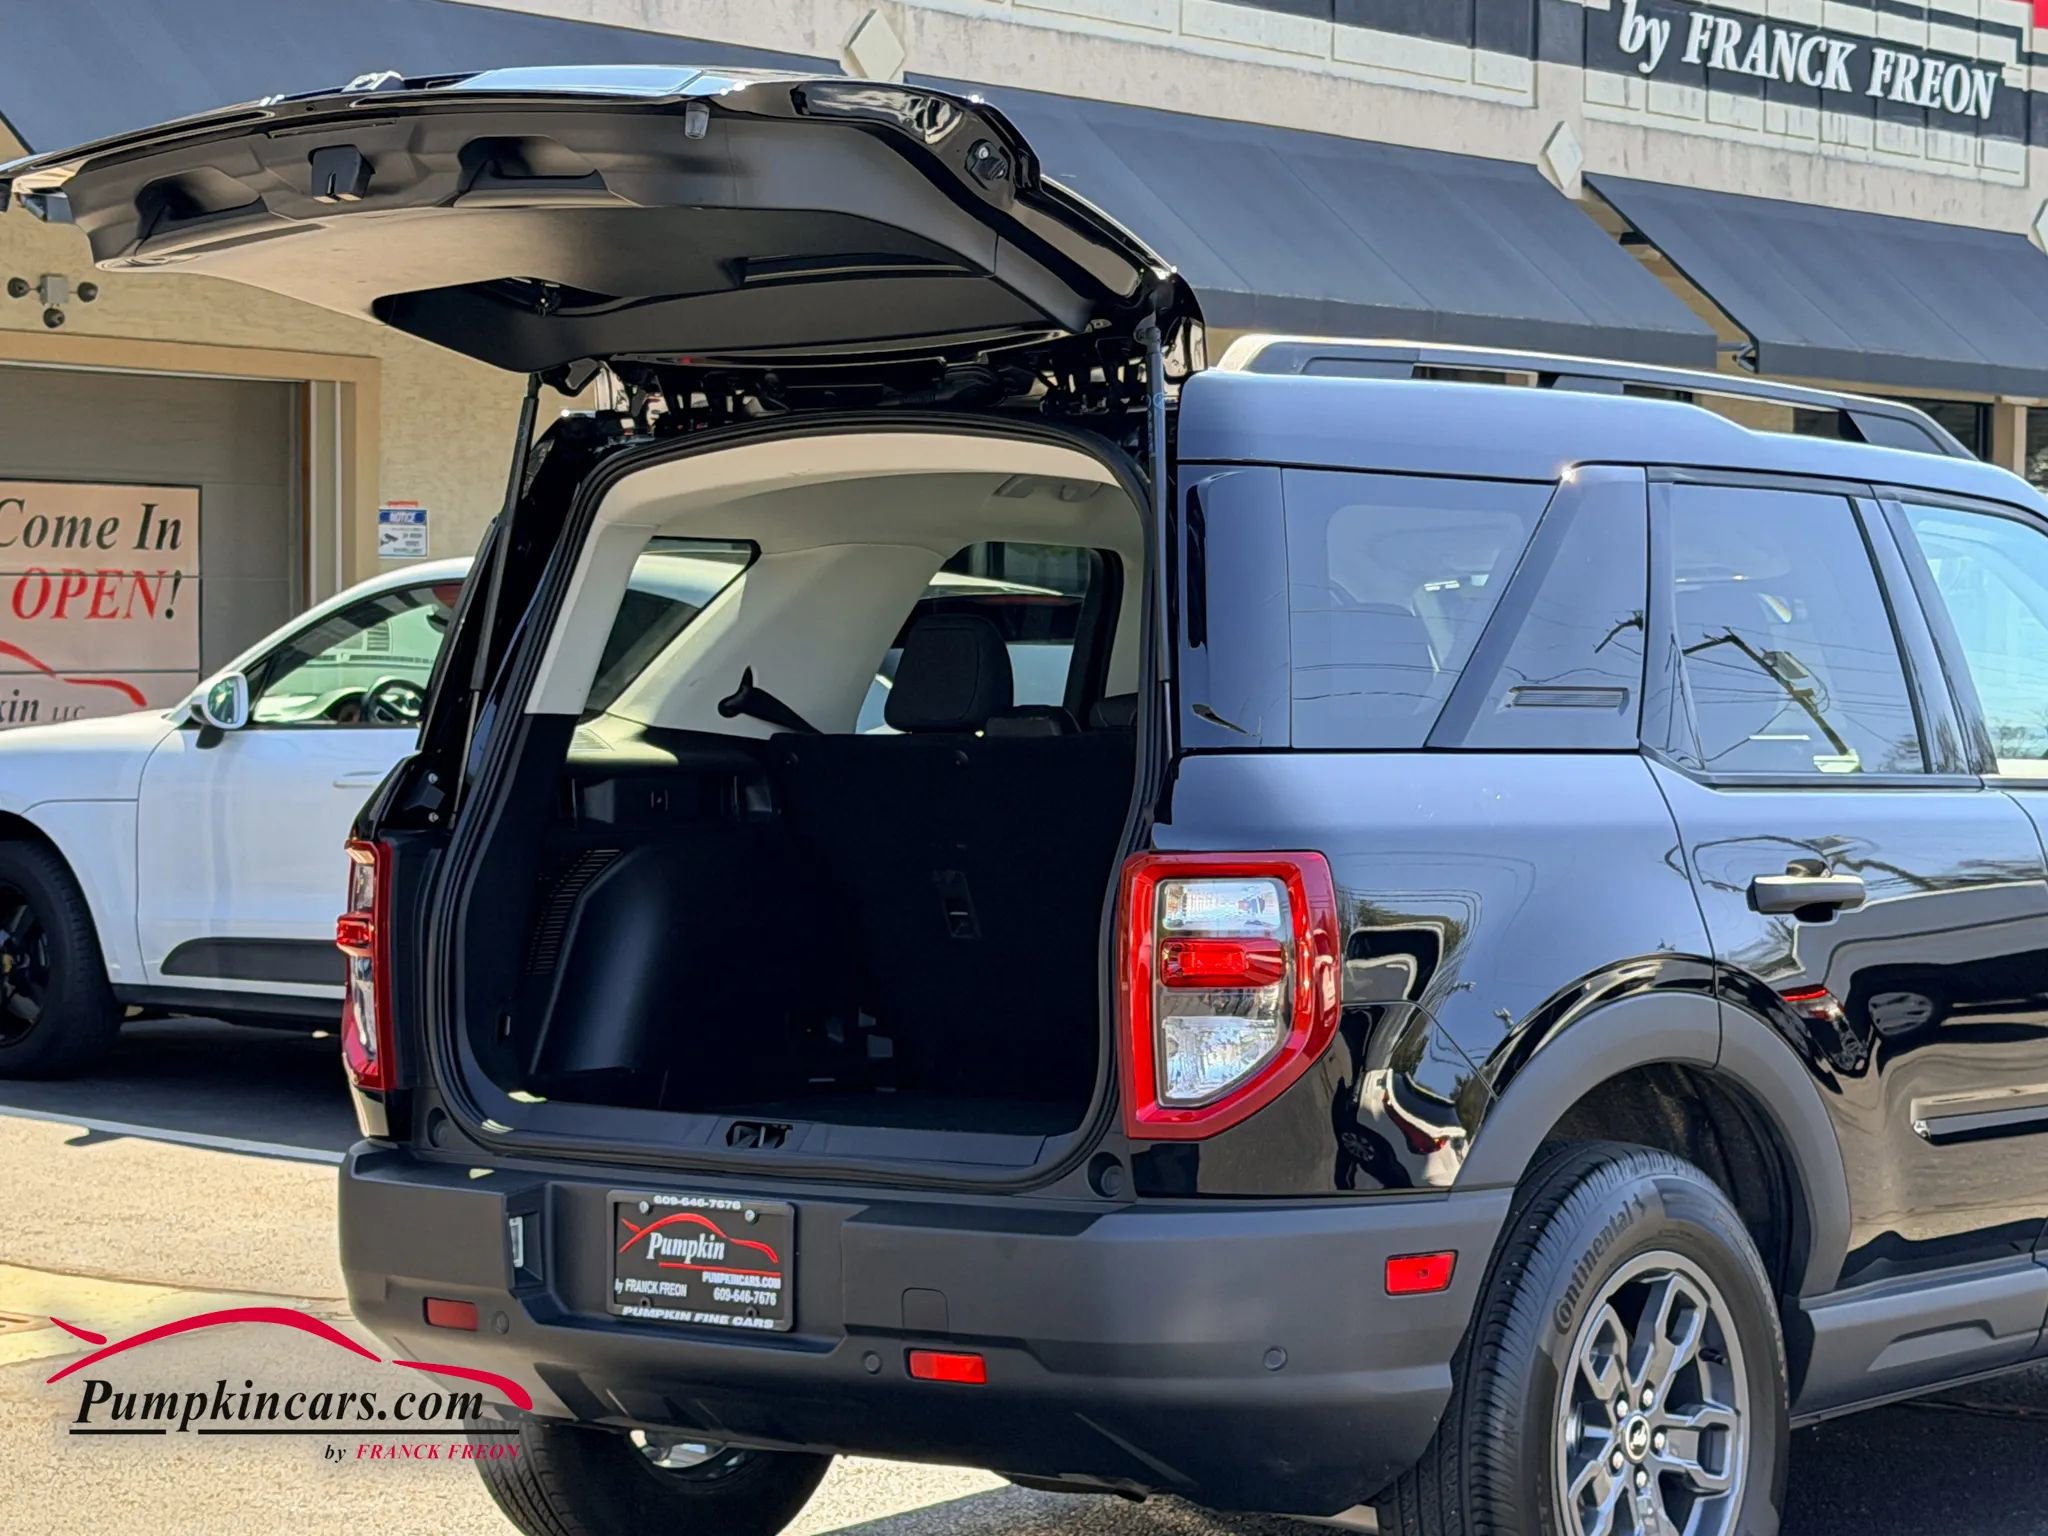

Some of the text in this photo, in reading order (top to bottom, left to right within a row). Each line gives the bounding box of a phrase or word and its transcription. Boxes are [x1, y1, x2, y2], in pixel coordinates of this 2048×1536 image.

[1619, 0, 1998, 120] by FRANCK FREON
[0, 498, 182, 550] Come In
[12, 567, 182, 620] OPEN!
[53, 705, 86, 721] LLC
[646, 1232, 725, 1264] Pumpkin
[1553, 1200, 1634, 1335] Continental
[614, 1278, 688, 1297] by FRANCK FREON
[622, 1306, 774, 1329] PUMPKIN FINE CARS
